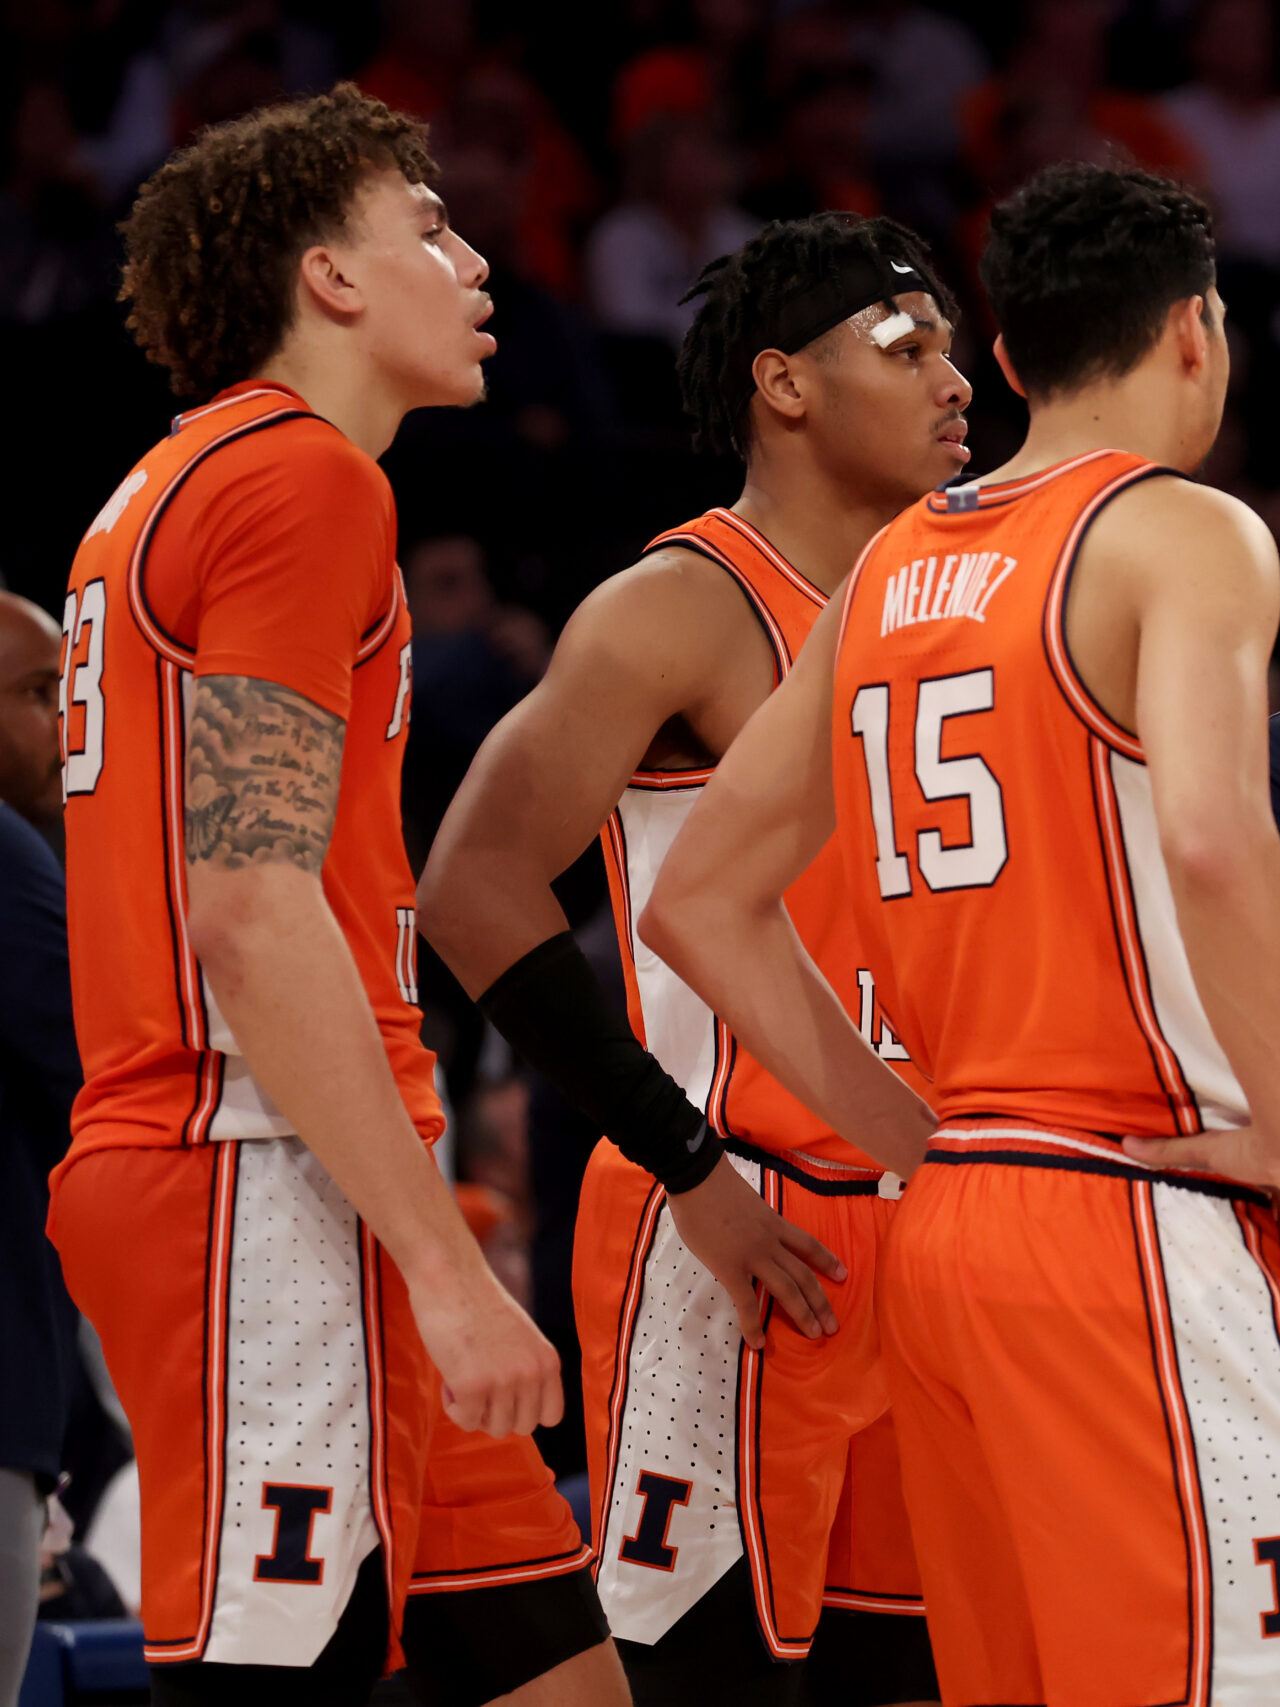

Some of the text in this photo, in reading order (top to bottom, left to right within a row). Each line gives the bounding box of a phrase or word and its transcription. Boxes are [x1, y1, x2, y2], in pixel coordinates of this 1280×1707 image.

[880, 551, 1018, 637] MELENDEZ
[850, 665, 1009, 902] 15
[253, 1481, 333, 1585] I
[619, 1469, 693, 1572] I
